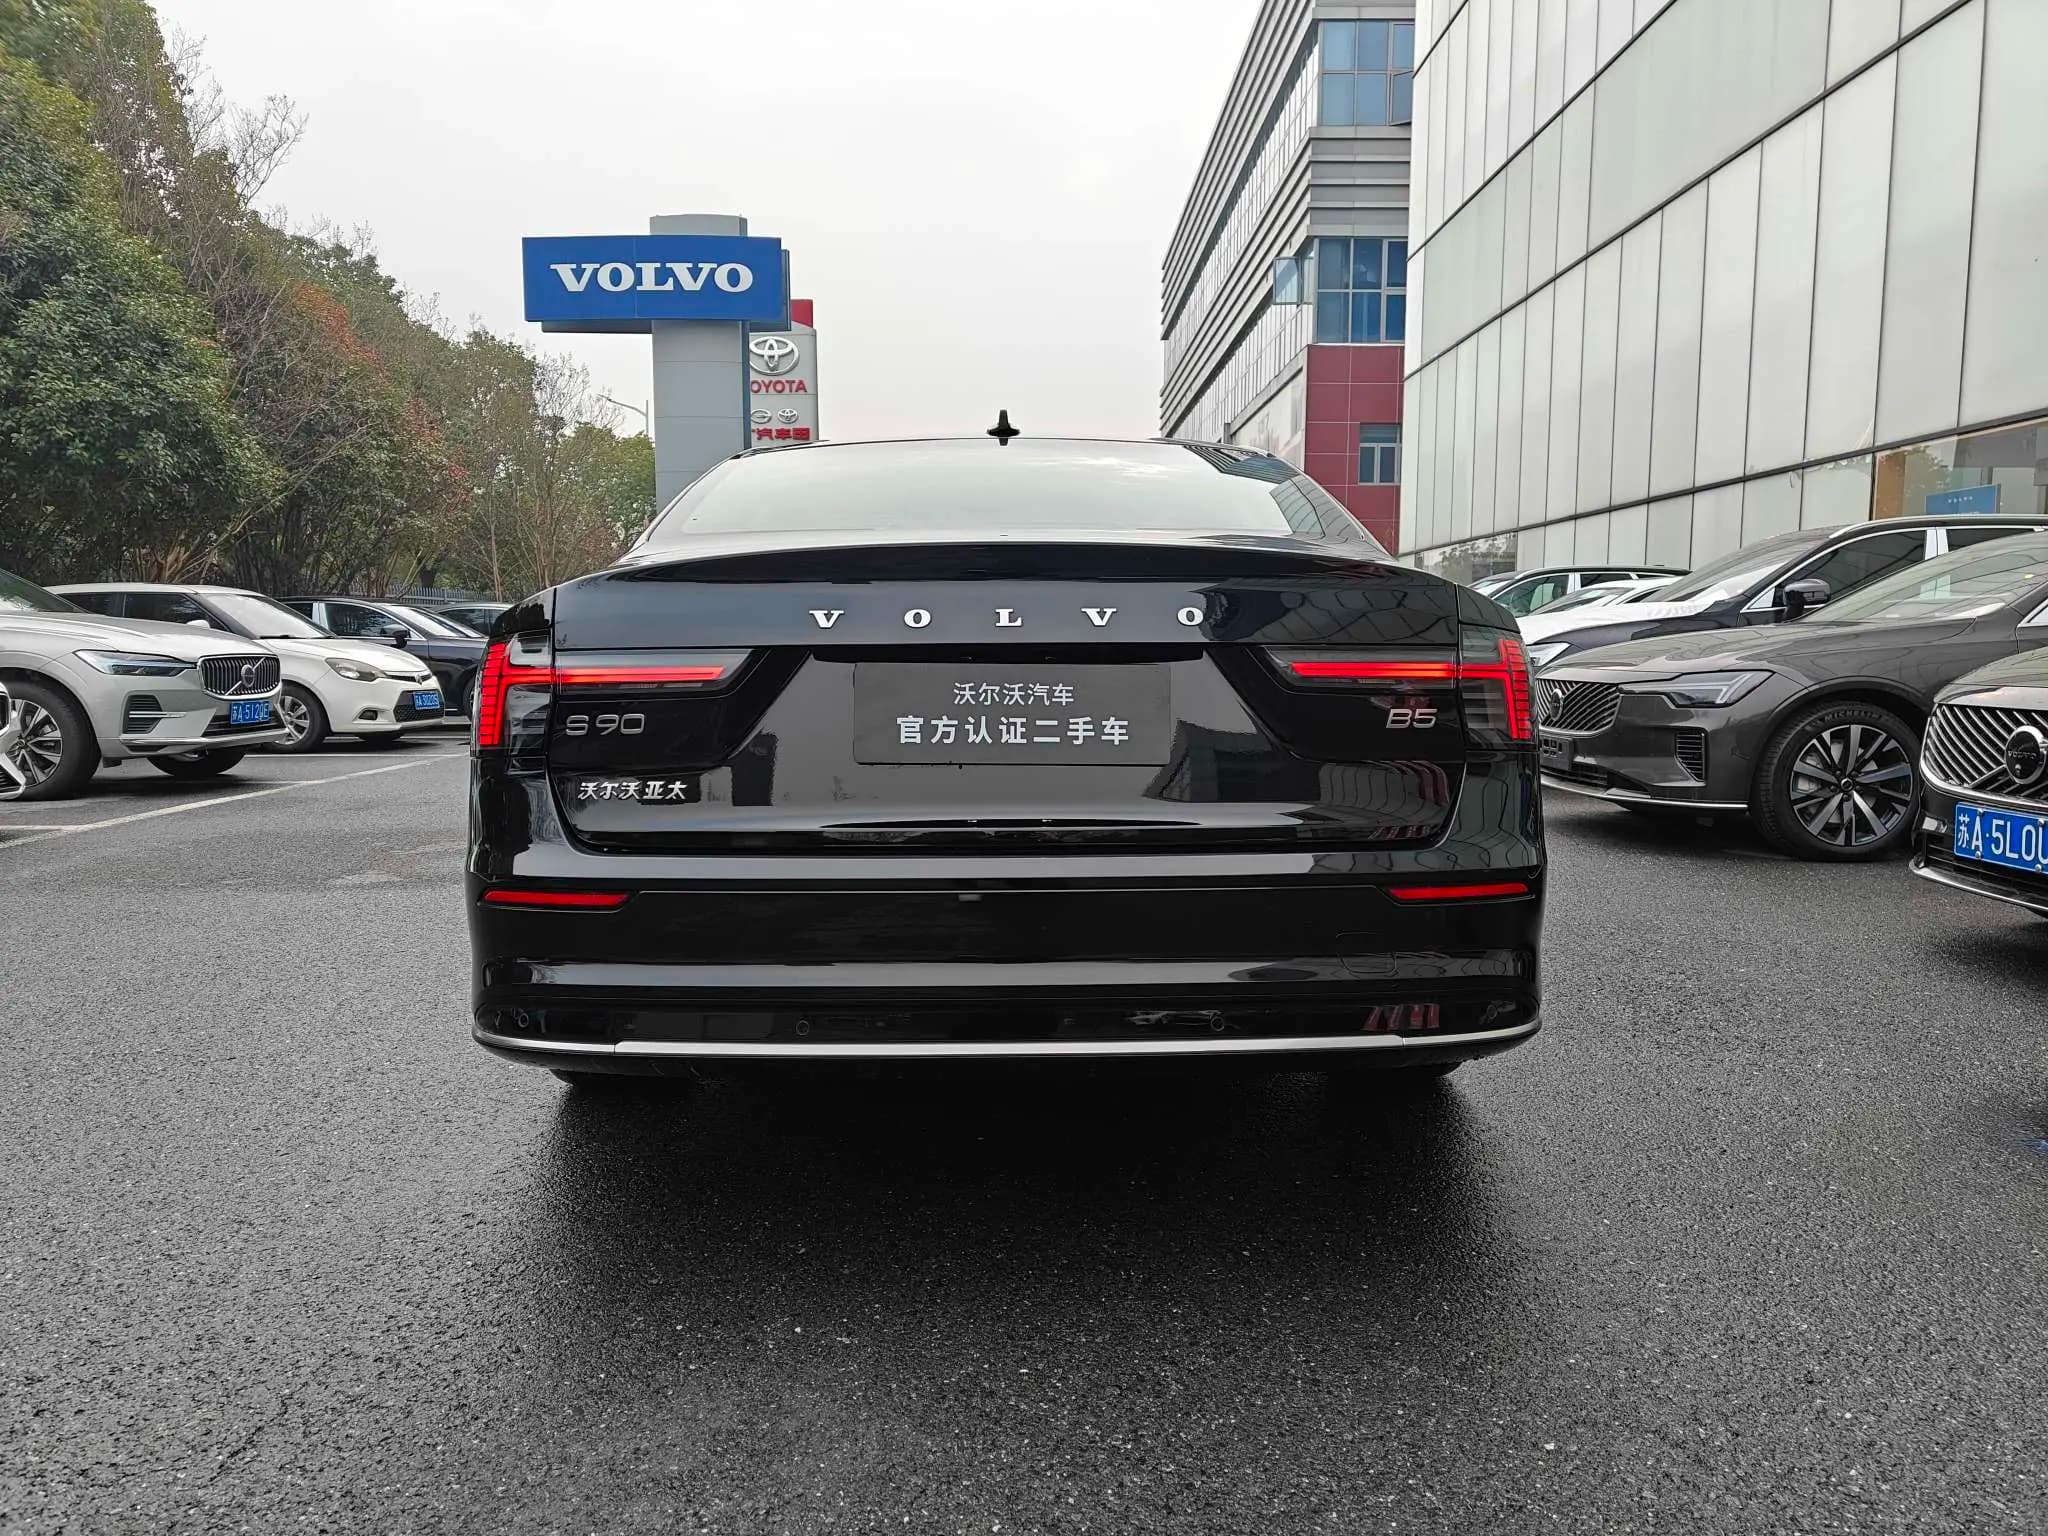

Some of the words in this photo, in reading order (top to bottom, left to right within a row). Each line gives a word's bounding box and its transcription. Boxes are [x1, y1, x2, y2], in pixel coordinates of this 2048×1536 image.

[550, 262, 753, 292] VOLVO
[751, 380, 807, 393] OYOTA
[752, 427, 810, 440] 汽丰田
[809, 607, 1204, 628] VOLVO
[953, 682, 1074, 706] 沃尔沃汽车
[566, 713, 645, 735] S90
[1386, 708, 1437, 728] B5
[896, 715, 1129, 745] 官方认证二手车
[577, 781, 687, 800] 沃尔沃亚太
